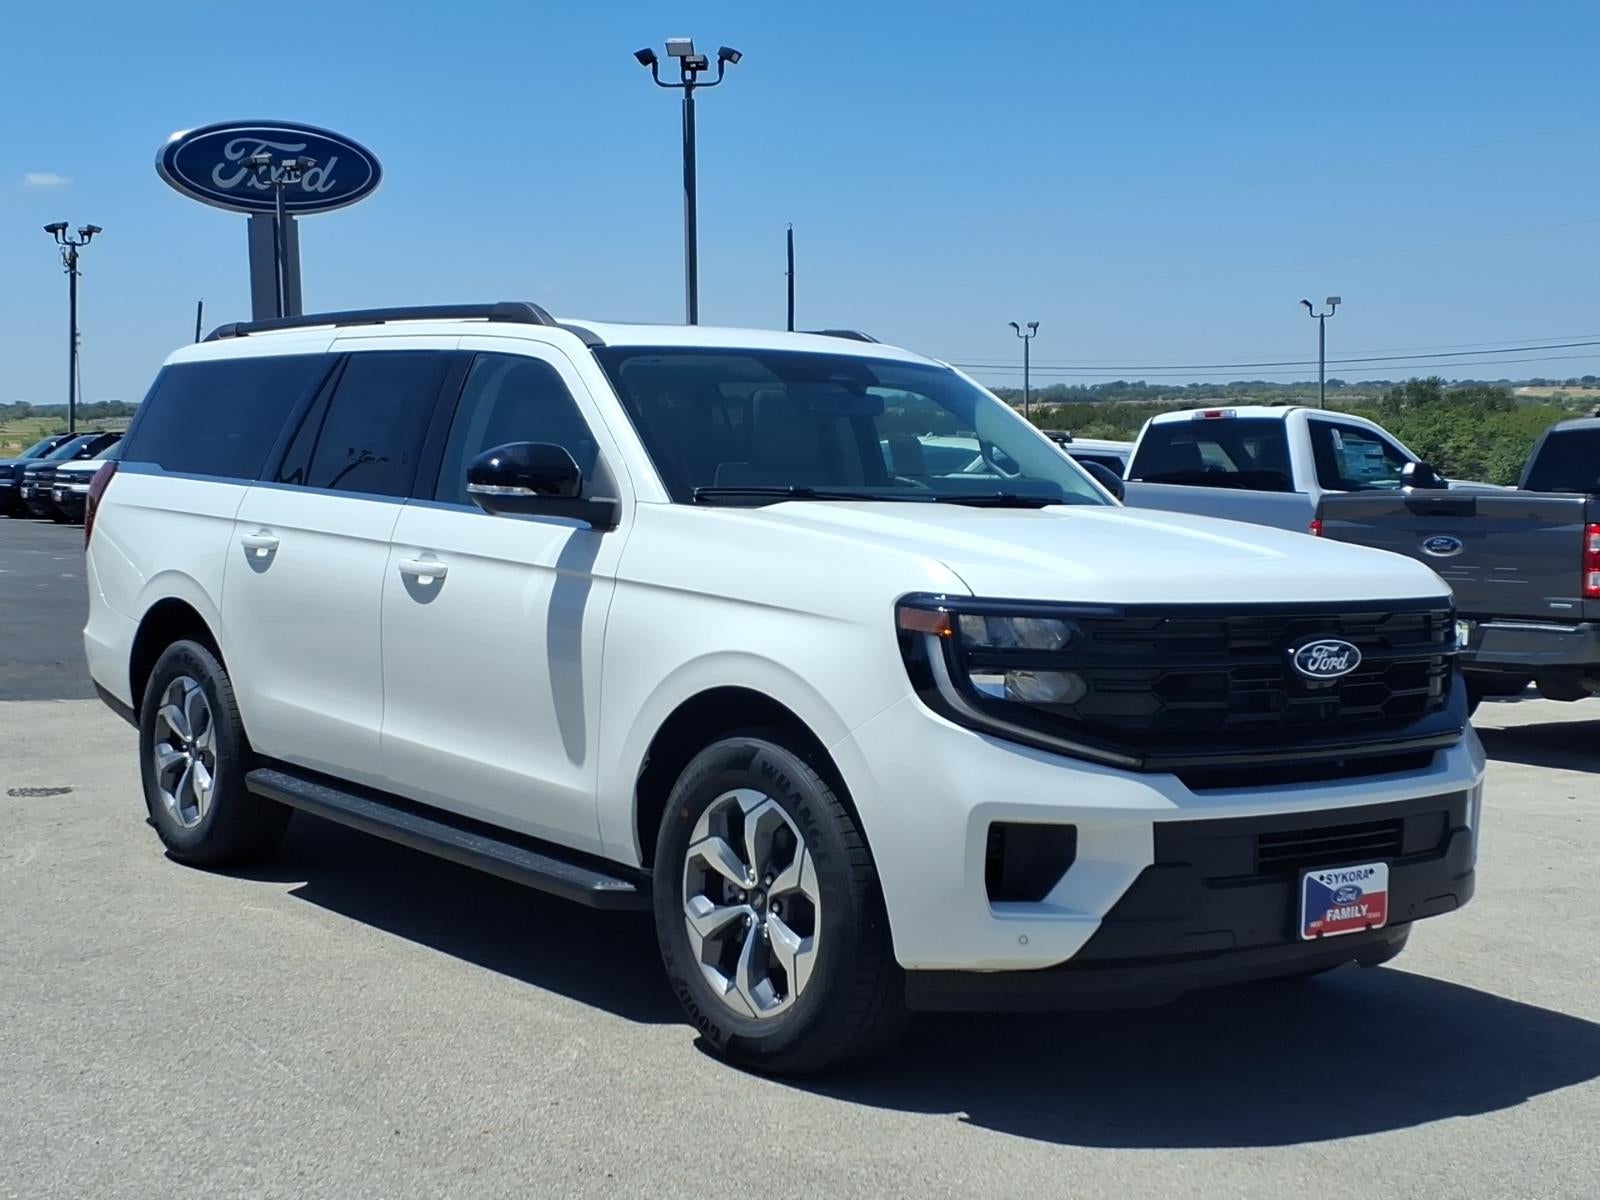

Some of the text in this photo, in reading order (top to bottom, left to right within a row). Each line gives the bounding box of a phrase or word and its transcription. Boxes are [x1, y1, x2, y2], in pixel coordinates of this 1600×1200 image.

[212, 138, 338, 192] Fod
[1308, 645, 1349, 671] Ford
[1325, 868, 1370, 885] SYKORA
[1326, 904, 1368, 922] FAMILY
